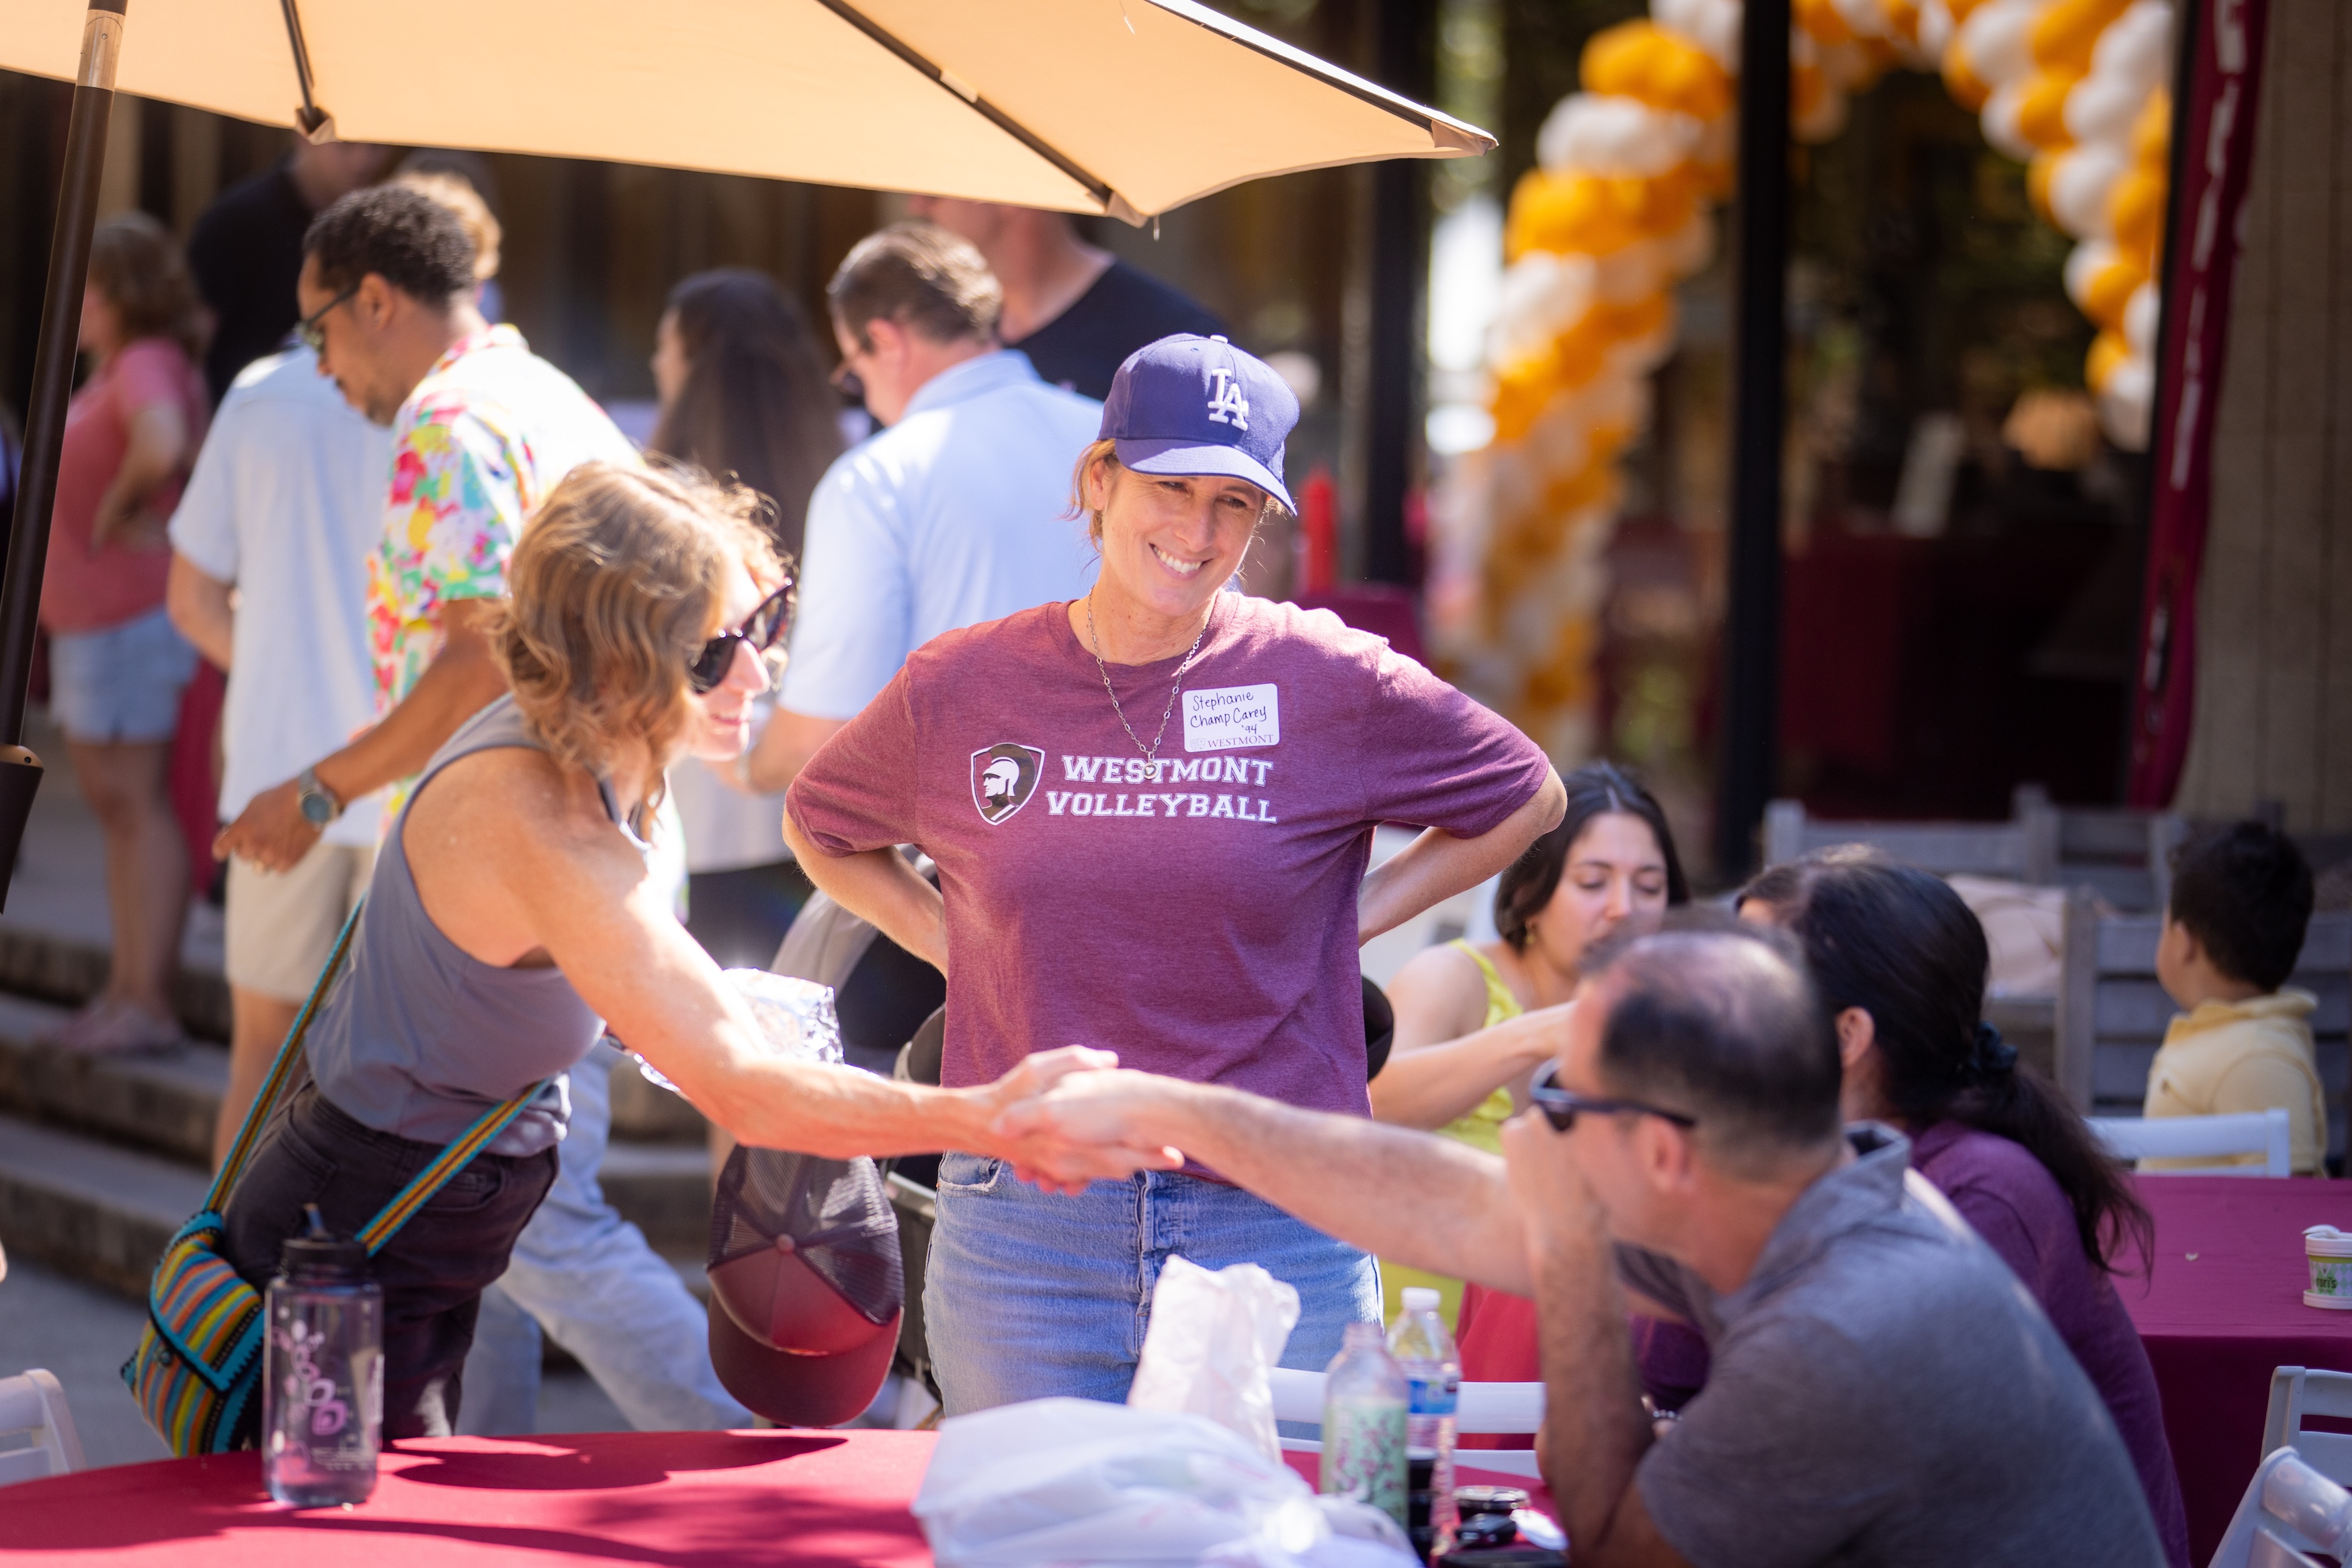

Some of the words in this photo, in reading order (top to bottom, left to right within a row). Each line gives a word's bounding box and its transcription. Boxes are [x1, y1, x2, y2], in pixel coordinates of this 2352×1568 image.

[1208, 369, 1249, 431] LA
[1193, 691, 1254, 711] Stephanie
[1190, 713, 1230, 728] Champ
[1233, 706, 1267, 723] Carey
[1241, 724, 1257, 734] '94
[1208, 734, 1274, 748] WESTMONT
[1062, 755, 1273, 787] WESTMONT
[1046, 791, 1277, 824] VOLLEYBALL
